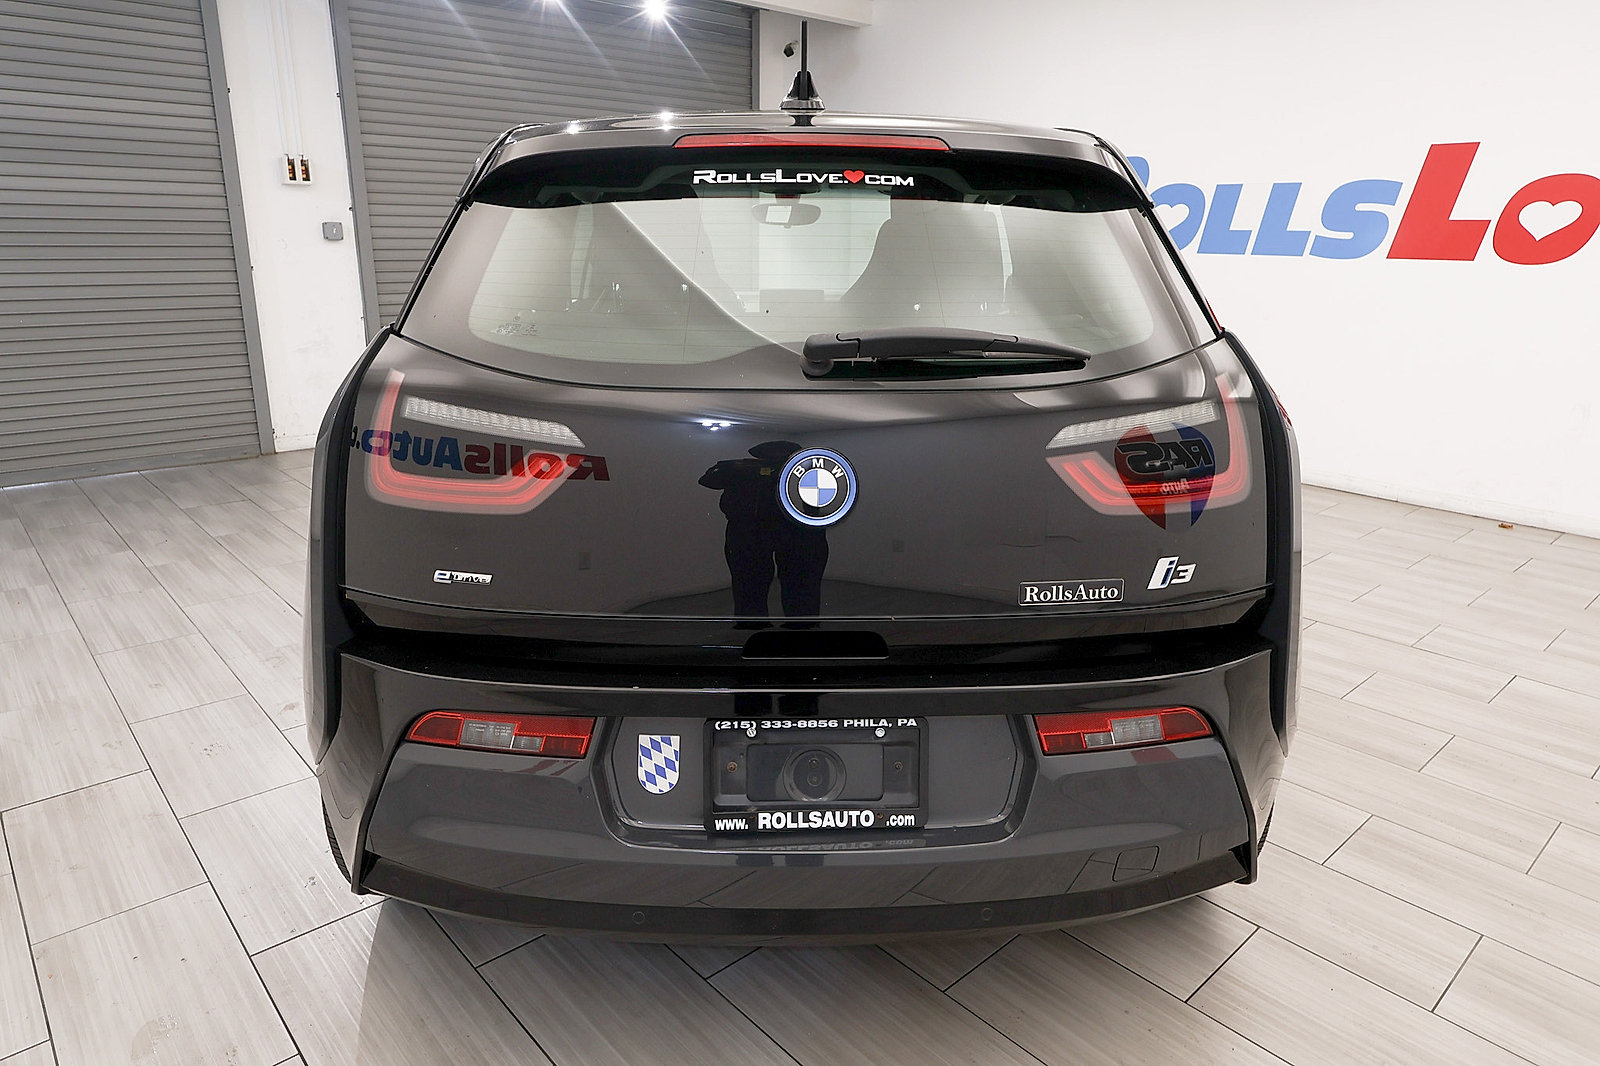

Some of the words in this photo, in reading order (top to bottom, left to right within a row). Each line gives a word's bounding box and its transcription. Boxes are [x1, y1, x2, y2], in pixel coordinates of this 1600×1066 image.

[793, 458, 845, 479] BMW
[1147, 556, 1197, 590] i3
[1024, 584, 1119, 603] RollsAuto
[714, 720, 757, 731] (215)
[761, 719, 839, 729] 333-8856
[843, 718, 893, 728] PHILA,
[897, 718, 918, 727] PA
[714, 818, 749, 831] www.
[757, 810, 875, 829] ROLLSAUTO
[886, 814, 915, 827] .com
